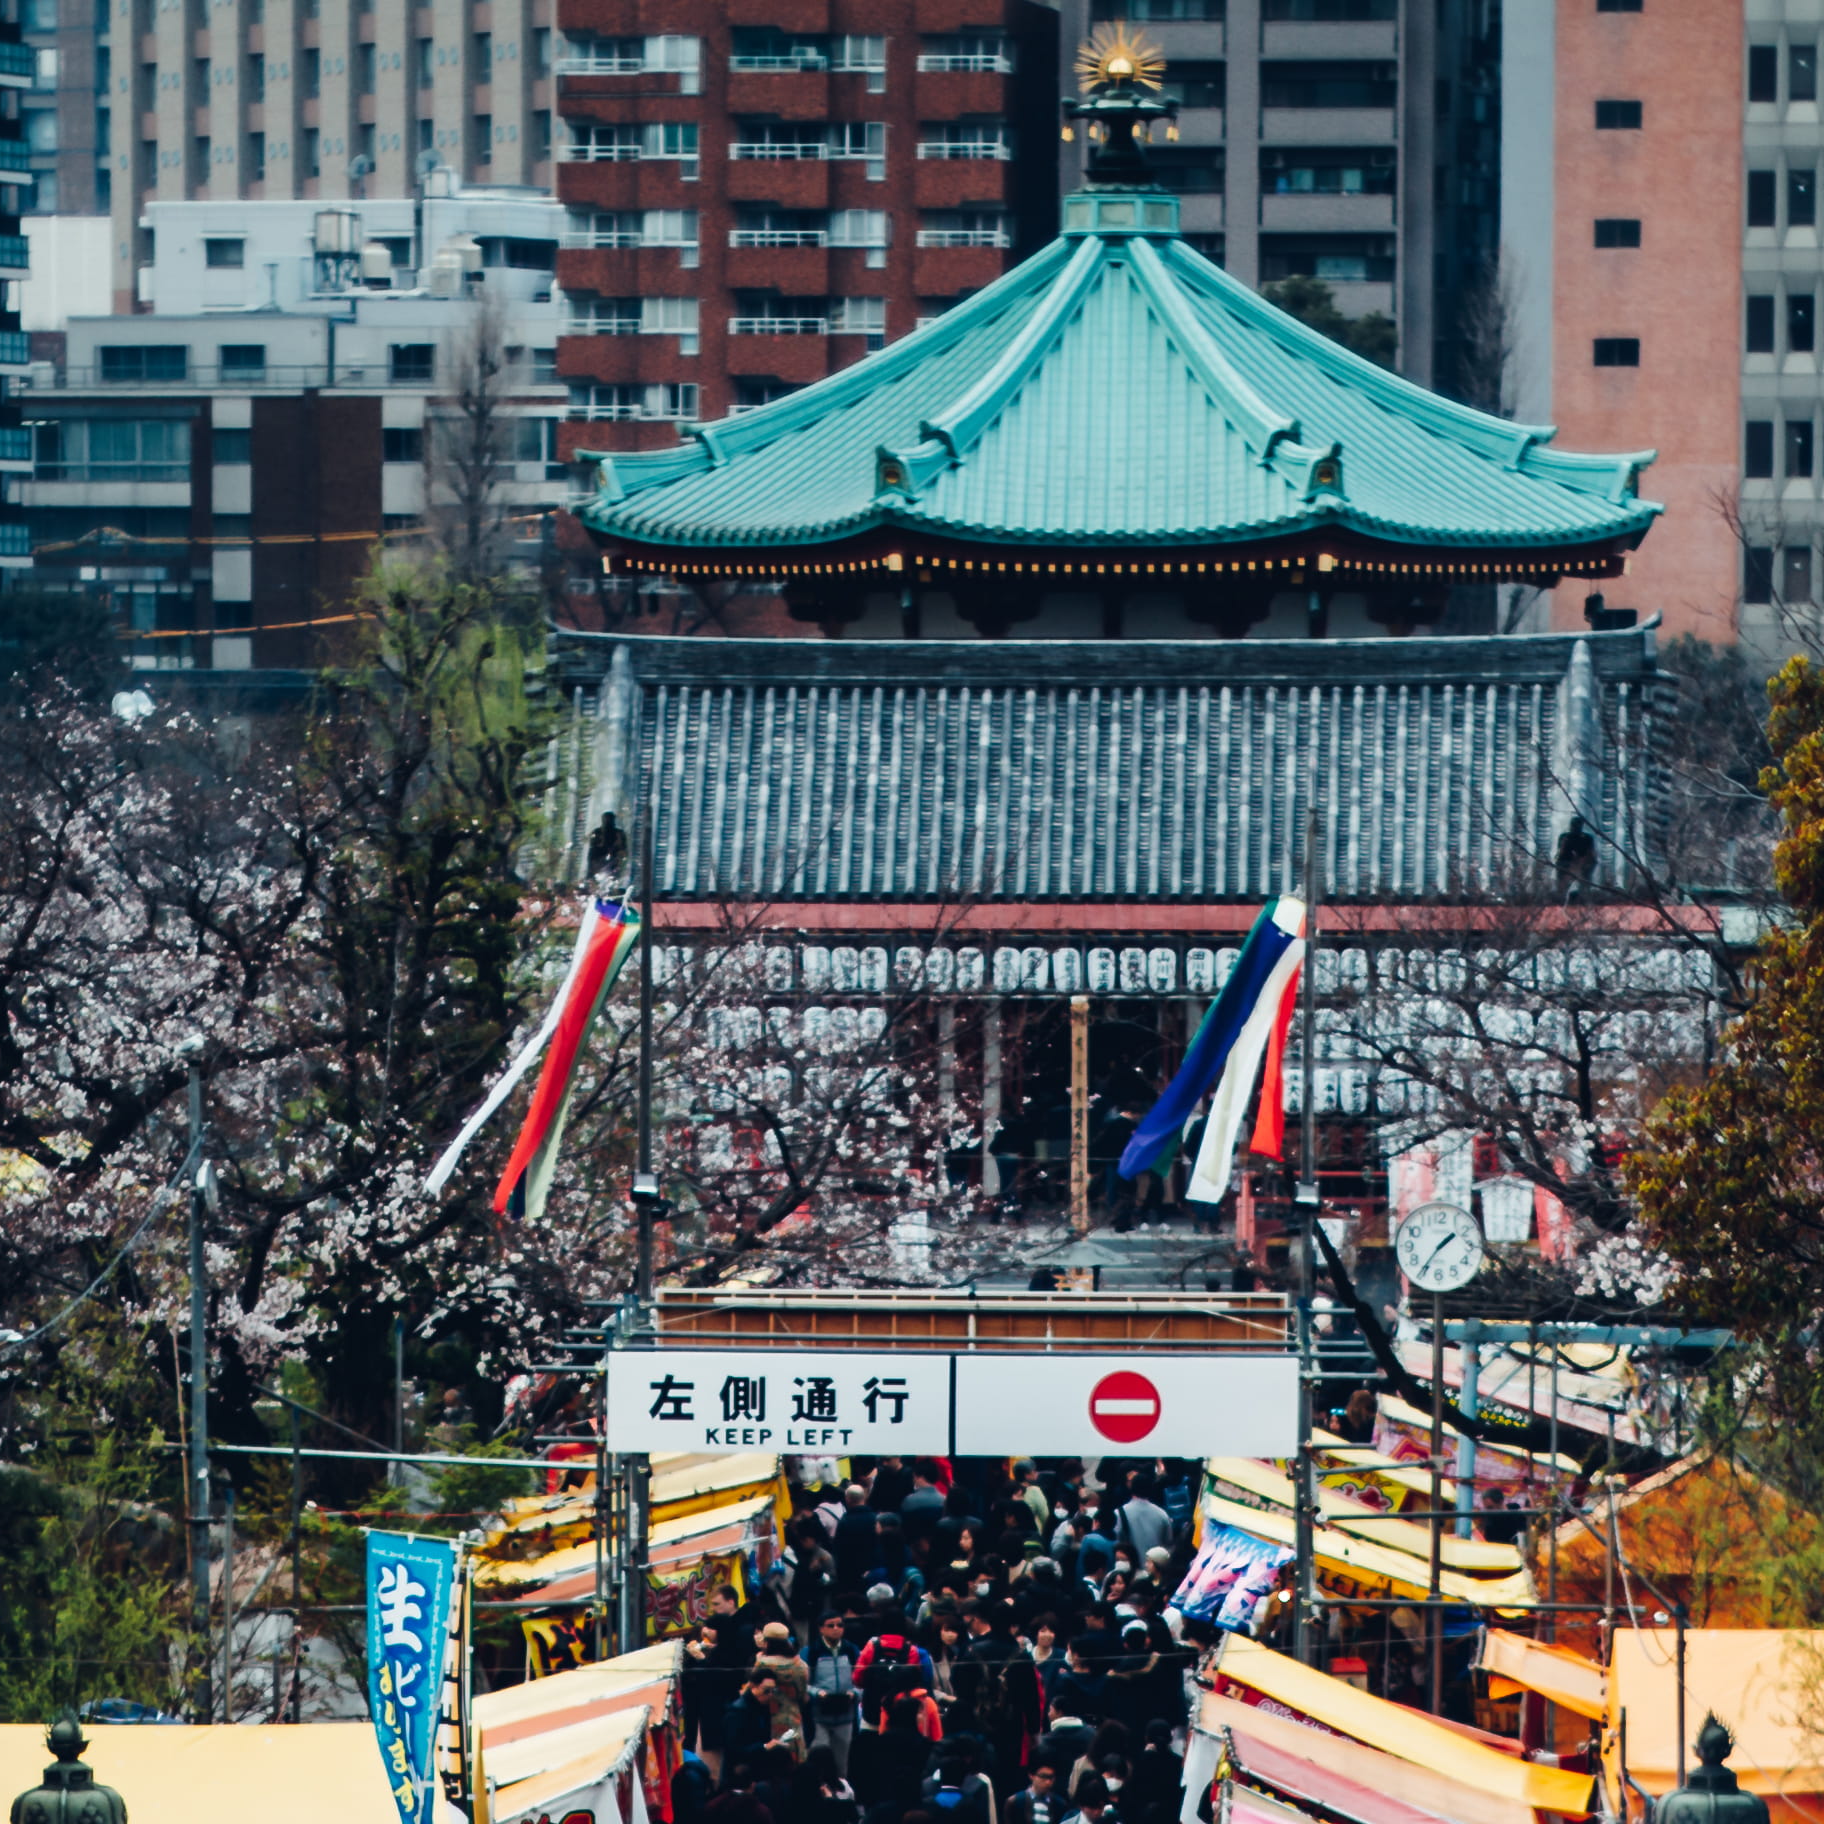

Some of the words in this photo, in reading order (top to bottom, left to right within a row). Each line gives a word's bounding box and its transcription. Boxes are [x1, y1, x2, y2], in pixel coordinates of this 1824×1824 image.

[649, 1374, 910, 1424] 左側通行
[705, 1428, 773, 1446] KEEP
[787, 1429, 854, 1446] LEFT
